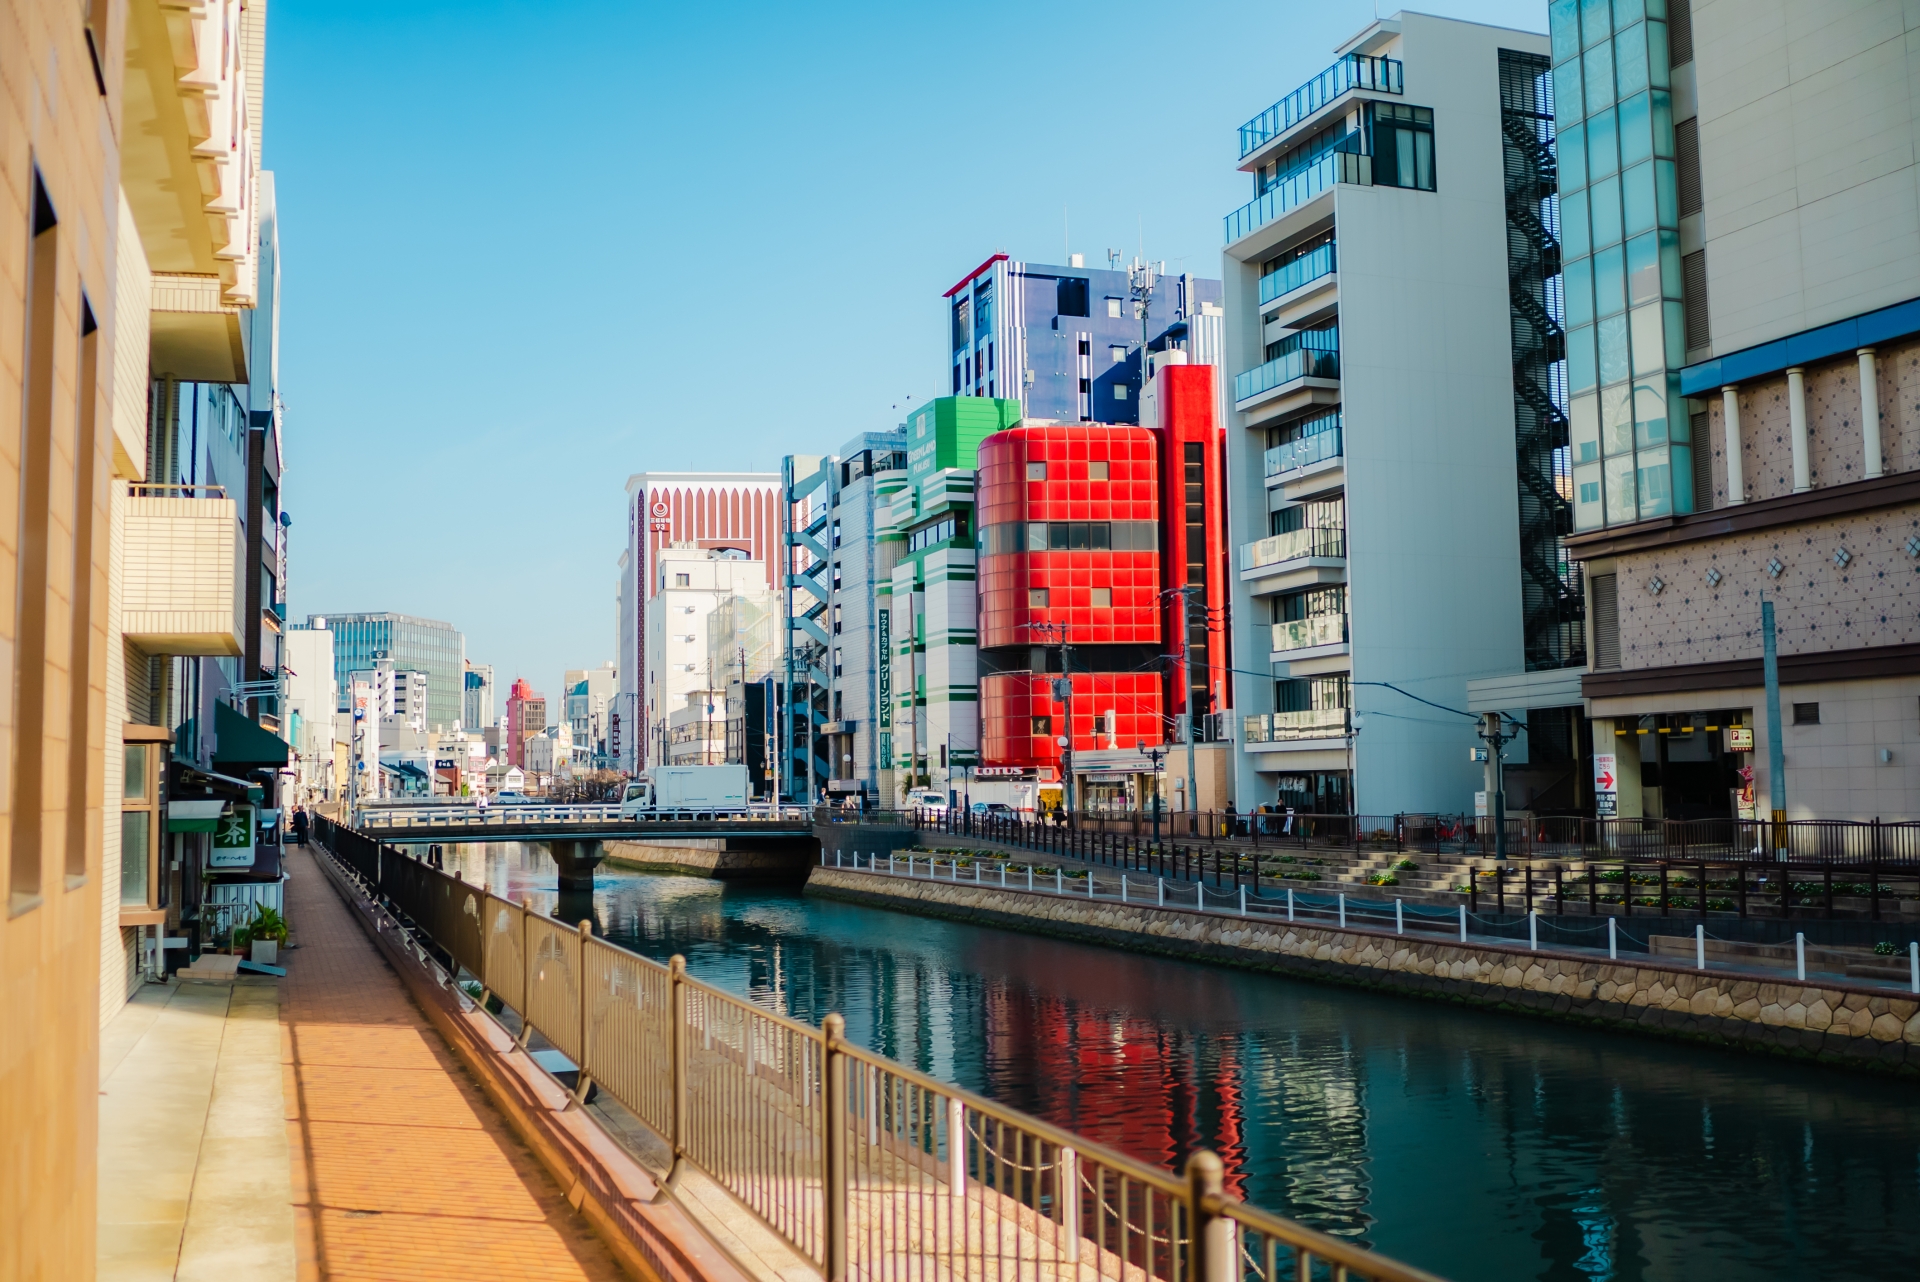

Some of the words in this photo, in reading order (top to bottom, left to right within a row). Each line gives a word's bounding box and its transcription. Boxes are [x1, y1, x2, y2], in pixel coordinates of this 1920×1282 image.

[908, 440, 936, 463] GREENLAND
[913, 458, 930, 475] NAKASU
[880, 663, 890, 722] グリーンランド
[973, 767, 1023, 776] LOTUS
[215, 813, 246, 845] 茶
